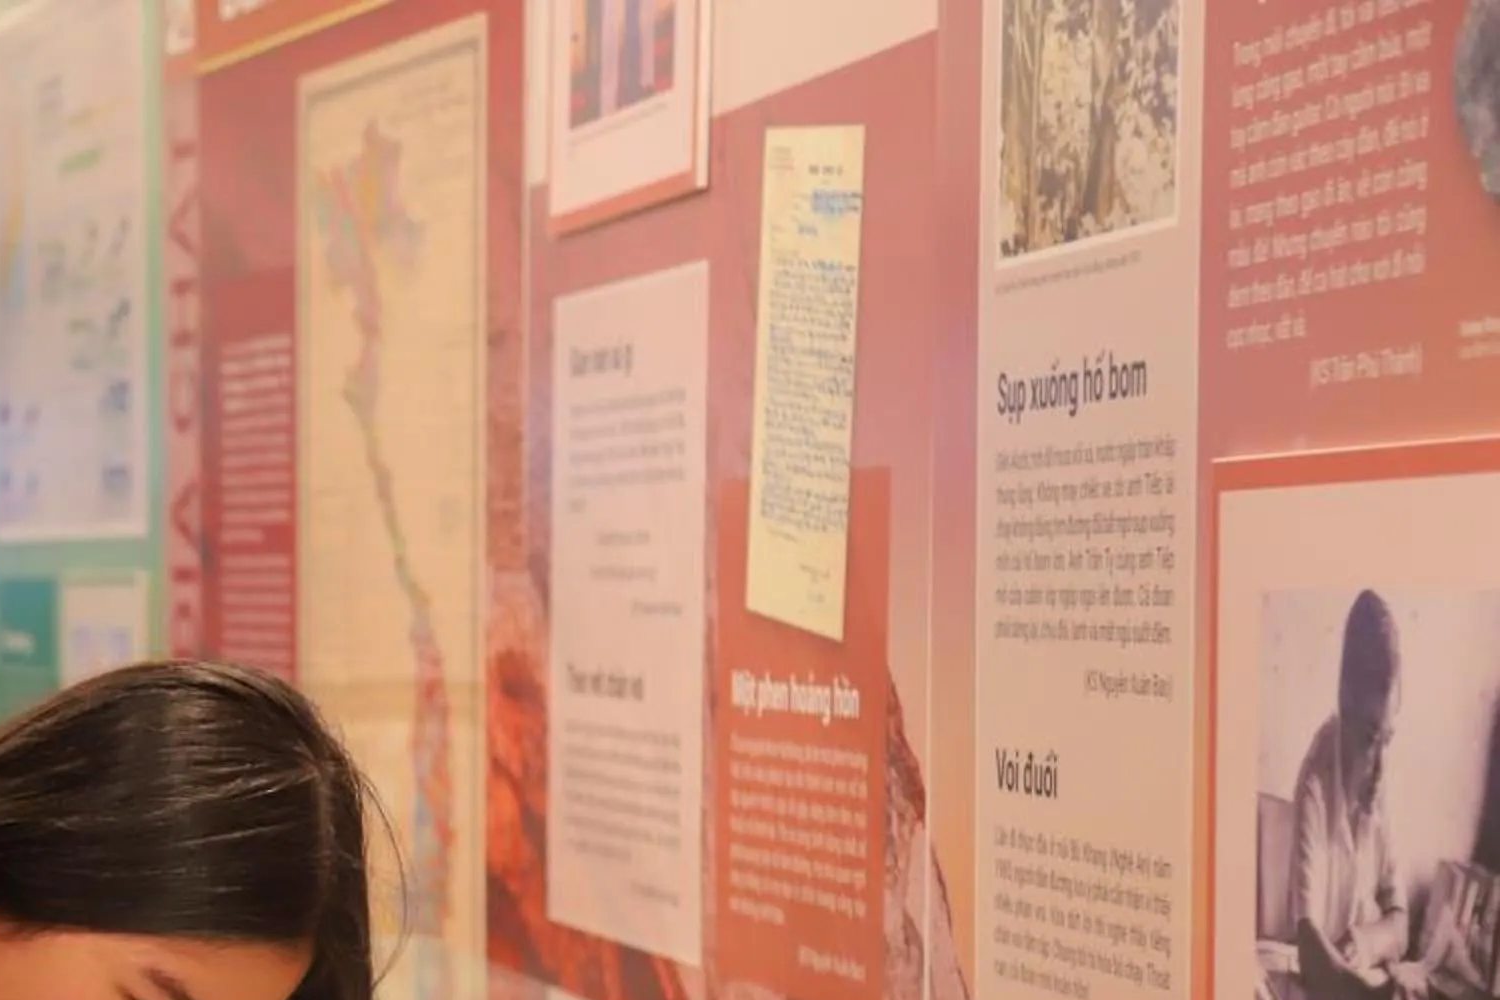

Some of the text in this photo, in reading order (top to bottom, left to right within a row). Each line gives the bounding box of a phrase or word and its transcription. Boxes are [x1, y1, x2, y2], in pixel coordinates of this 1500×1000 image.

[996, 348, 1148, 425] Sụp xuống hố bom
[731, 668, 756, 717] Một
[757, 669, 789, 718] phen
[833, 672, 861, 720] hồn
[995, 747, 1019, 793] Voi
